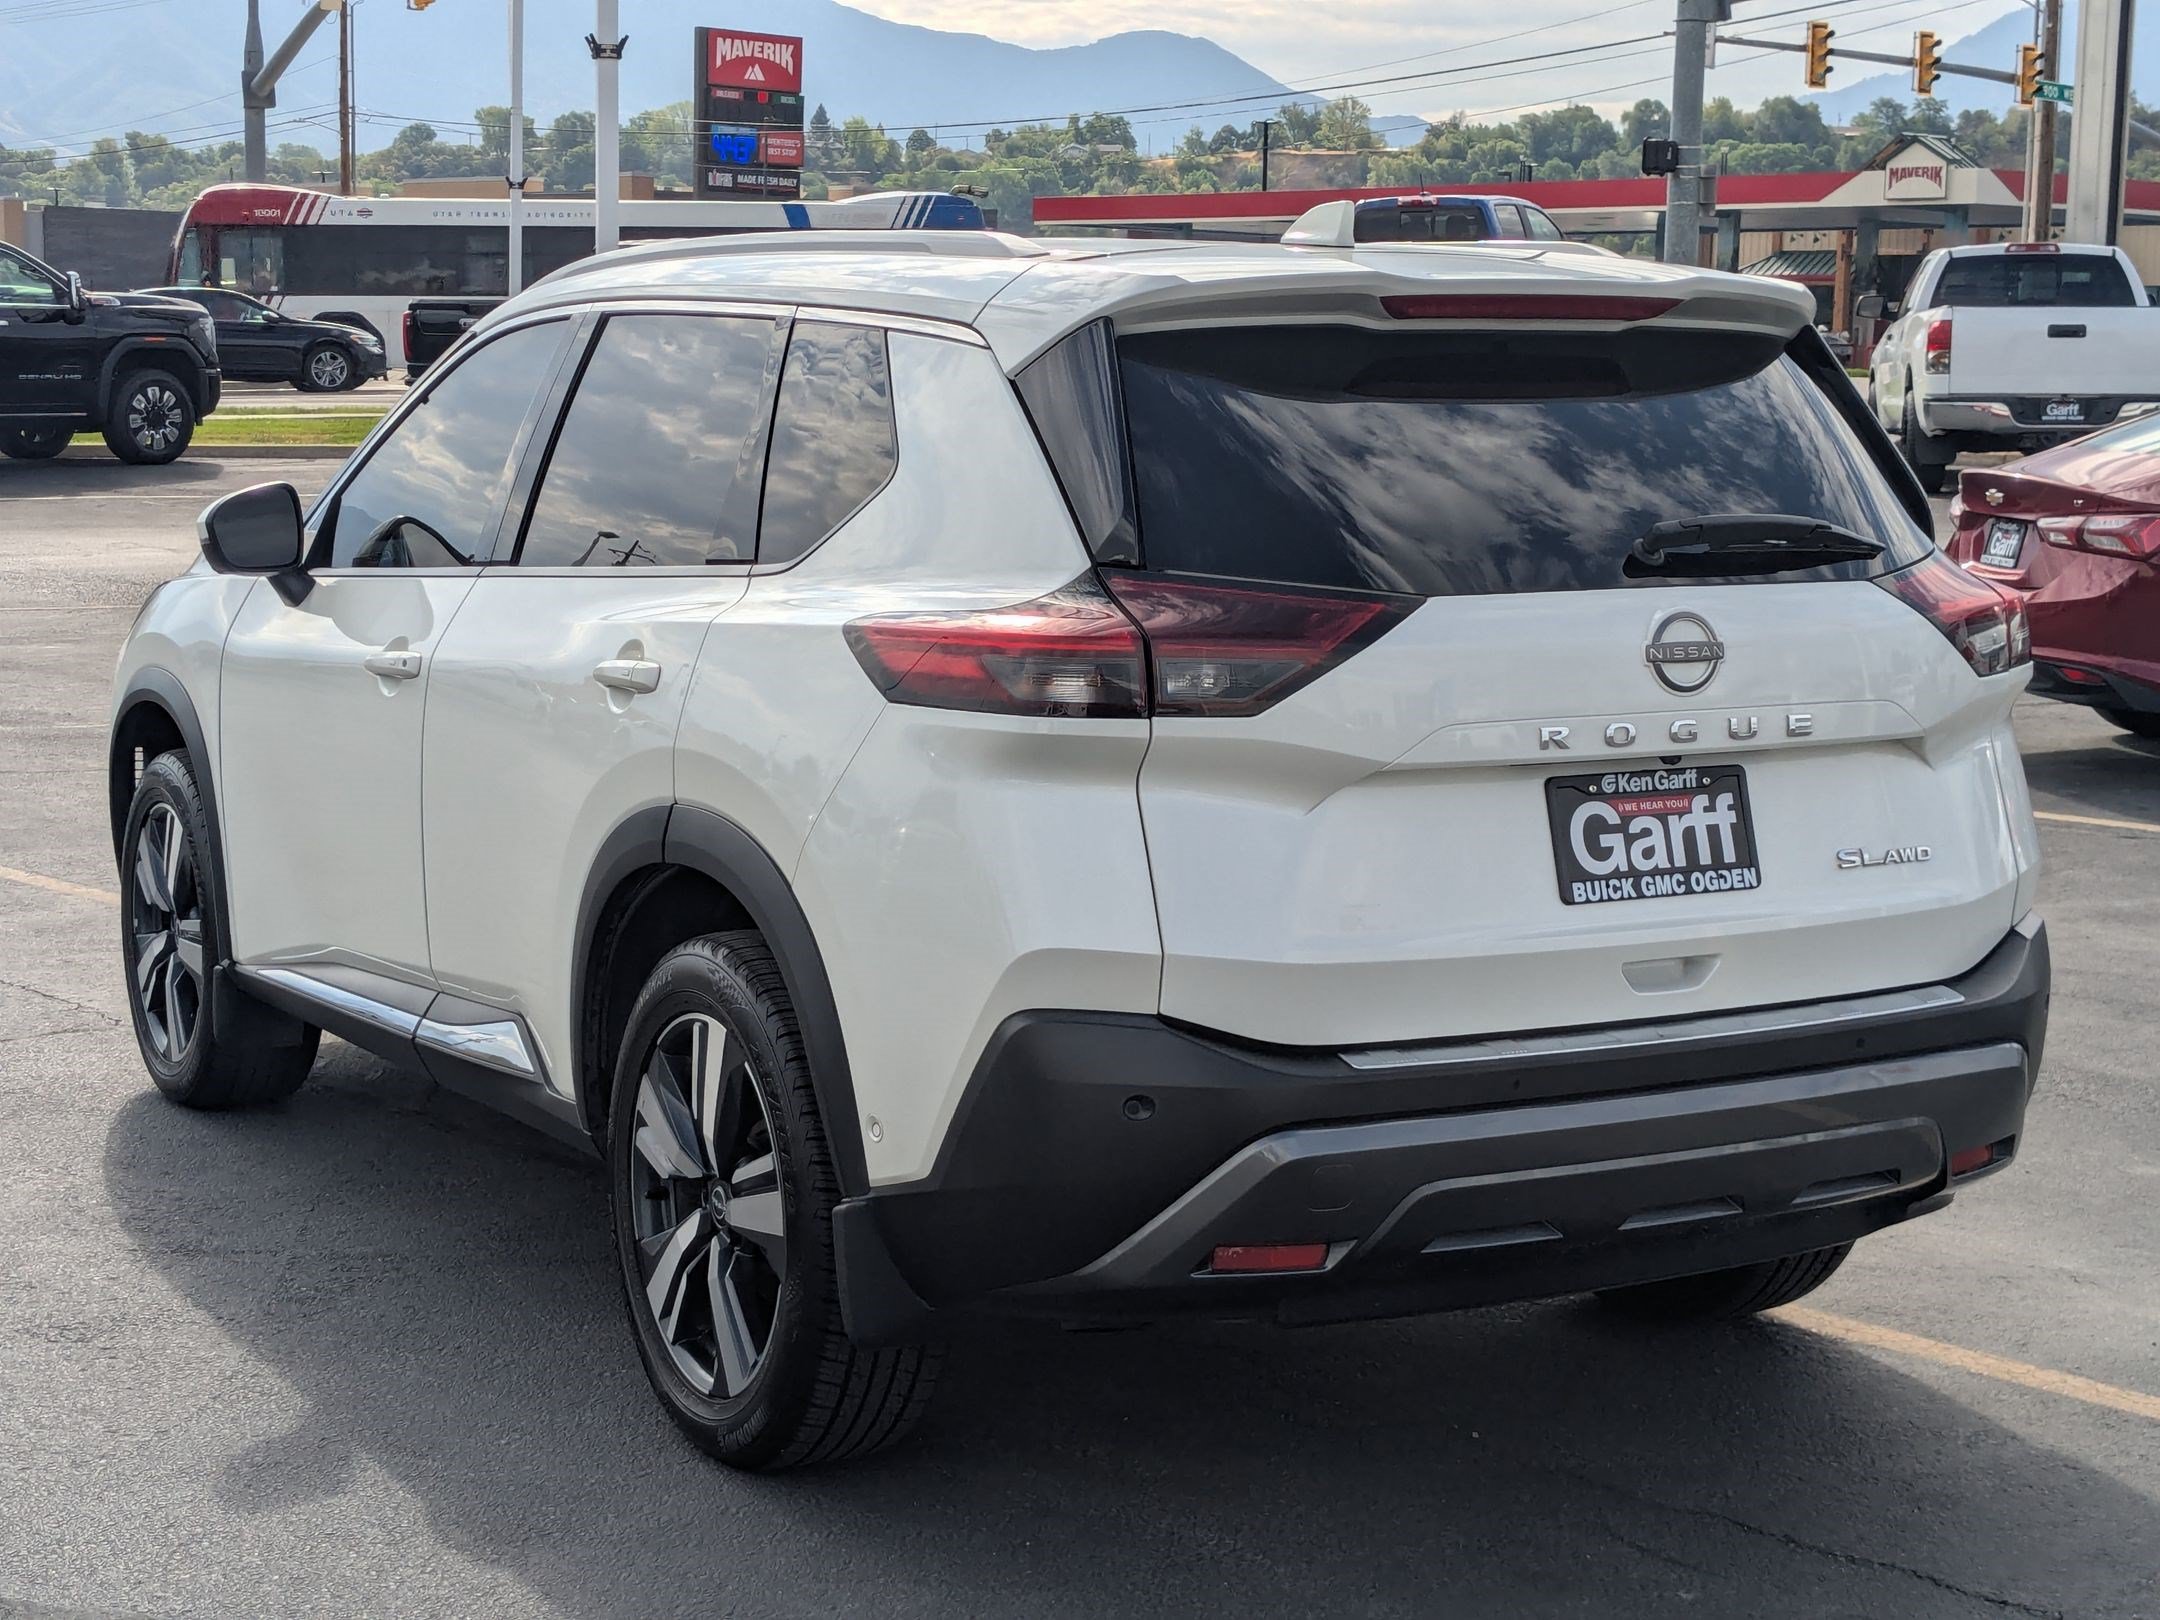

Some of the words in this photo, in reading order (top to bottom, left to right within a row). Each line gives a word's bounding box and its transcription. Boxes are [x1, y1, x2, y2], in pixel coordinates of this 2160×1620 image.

[716, 37, 795, 76] MAVERIK
[737, 174, 756, 184] MADE
[1888, 166, 1943, 190] MAVERIK
[2046, 403, 2080, 416] Garff
[1990, 531, 2020, 556] Garff
[1649, 645, 1723, 659] NISSAN
[1539, 714, 1813, 750] ROGUE
[1618, 773, 1653, 793] Ken
[1653, 768, 1697, 792] Garff
[1624, 802, 1638, 812] WE
[1640, 801, 1664, 810] HEAR
[1665, 798, 1683, 808] YOU
[1569, 792, 1737, 876] Garff
[1837, 848, 1885, 869] SL
[1885, 846, 1931, 864] AWD
[1571, 877, 1635, 902] BUICK
[1640, 873, 1686, 897] GMC
[1690, 867, 1760, 892] OGDEN
